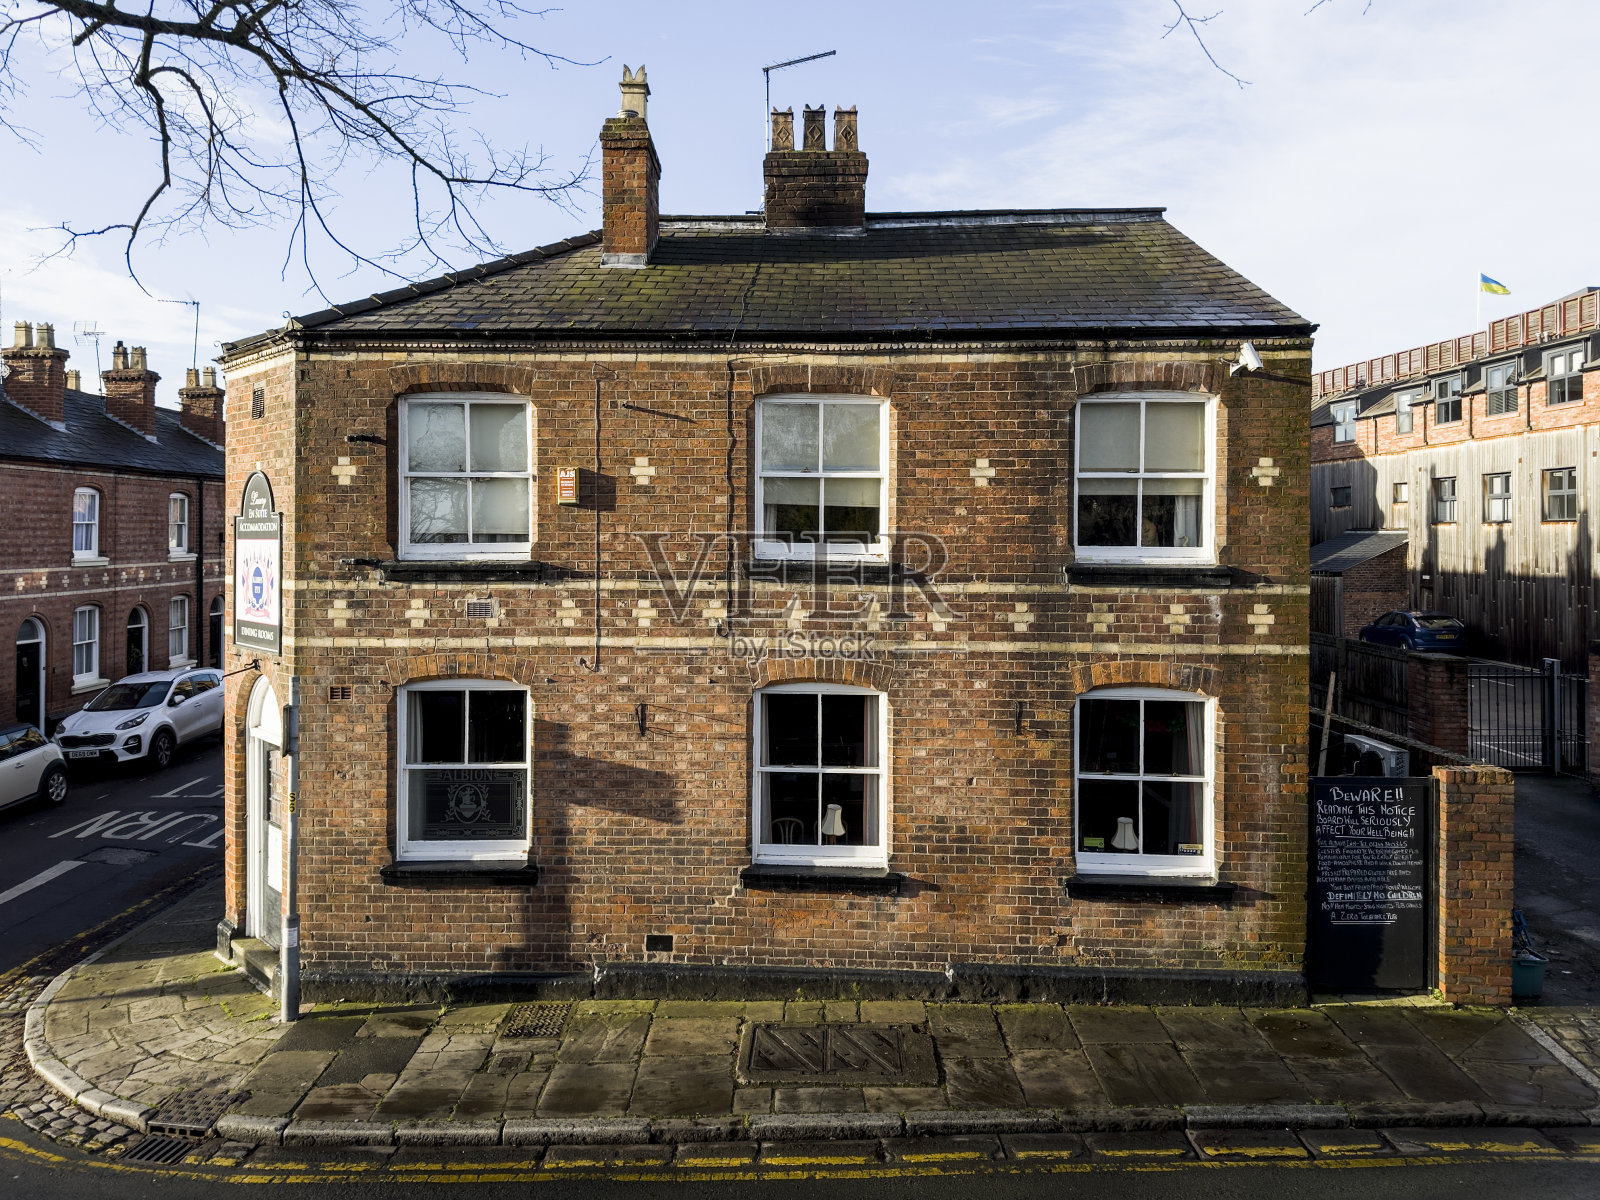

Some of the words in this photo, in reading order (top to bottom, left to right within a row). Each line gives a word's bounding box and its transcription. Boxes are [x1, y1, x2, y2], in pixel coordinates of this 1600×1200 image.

[241, 626, 258, 638] DINING
[258, 628, 274, 641] ROOMS
[441, 769, 493, 781] ALBION
[1330, 787, 1403, 802] BEWARE!!
[1317, 799, 1354, 814] READING
[1356, 803, 1376, 815] THIS
[1381, 803, 1416, 816] NOTICE
[1317, 814, 1343, 824] BOARD
[1344, 815, 1360, 825] WILL
[1360, 816, 1411, 827] SERIOUSLY
[1316, 825, 1346, 835] AFFECT
[1348, 825, 1366, 836] YOUR
[1326, 891, 1372, 900] DEFINITELY
[1373, 891, 1386, 900] NO
[1387, 890, 1423, 899] CHILDREN
[1340, 911, 1358, 920] ZERO
[1386, 912, 1398, 920] PUB
